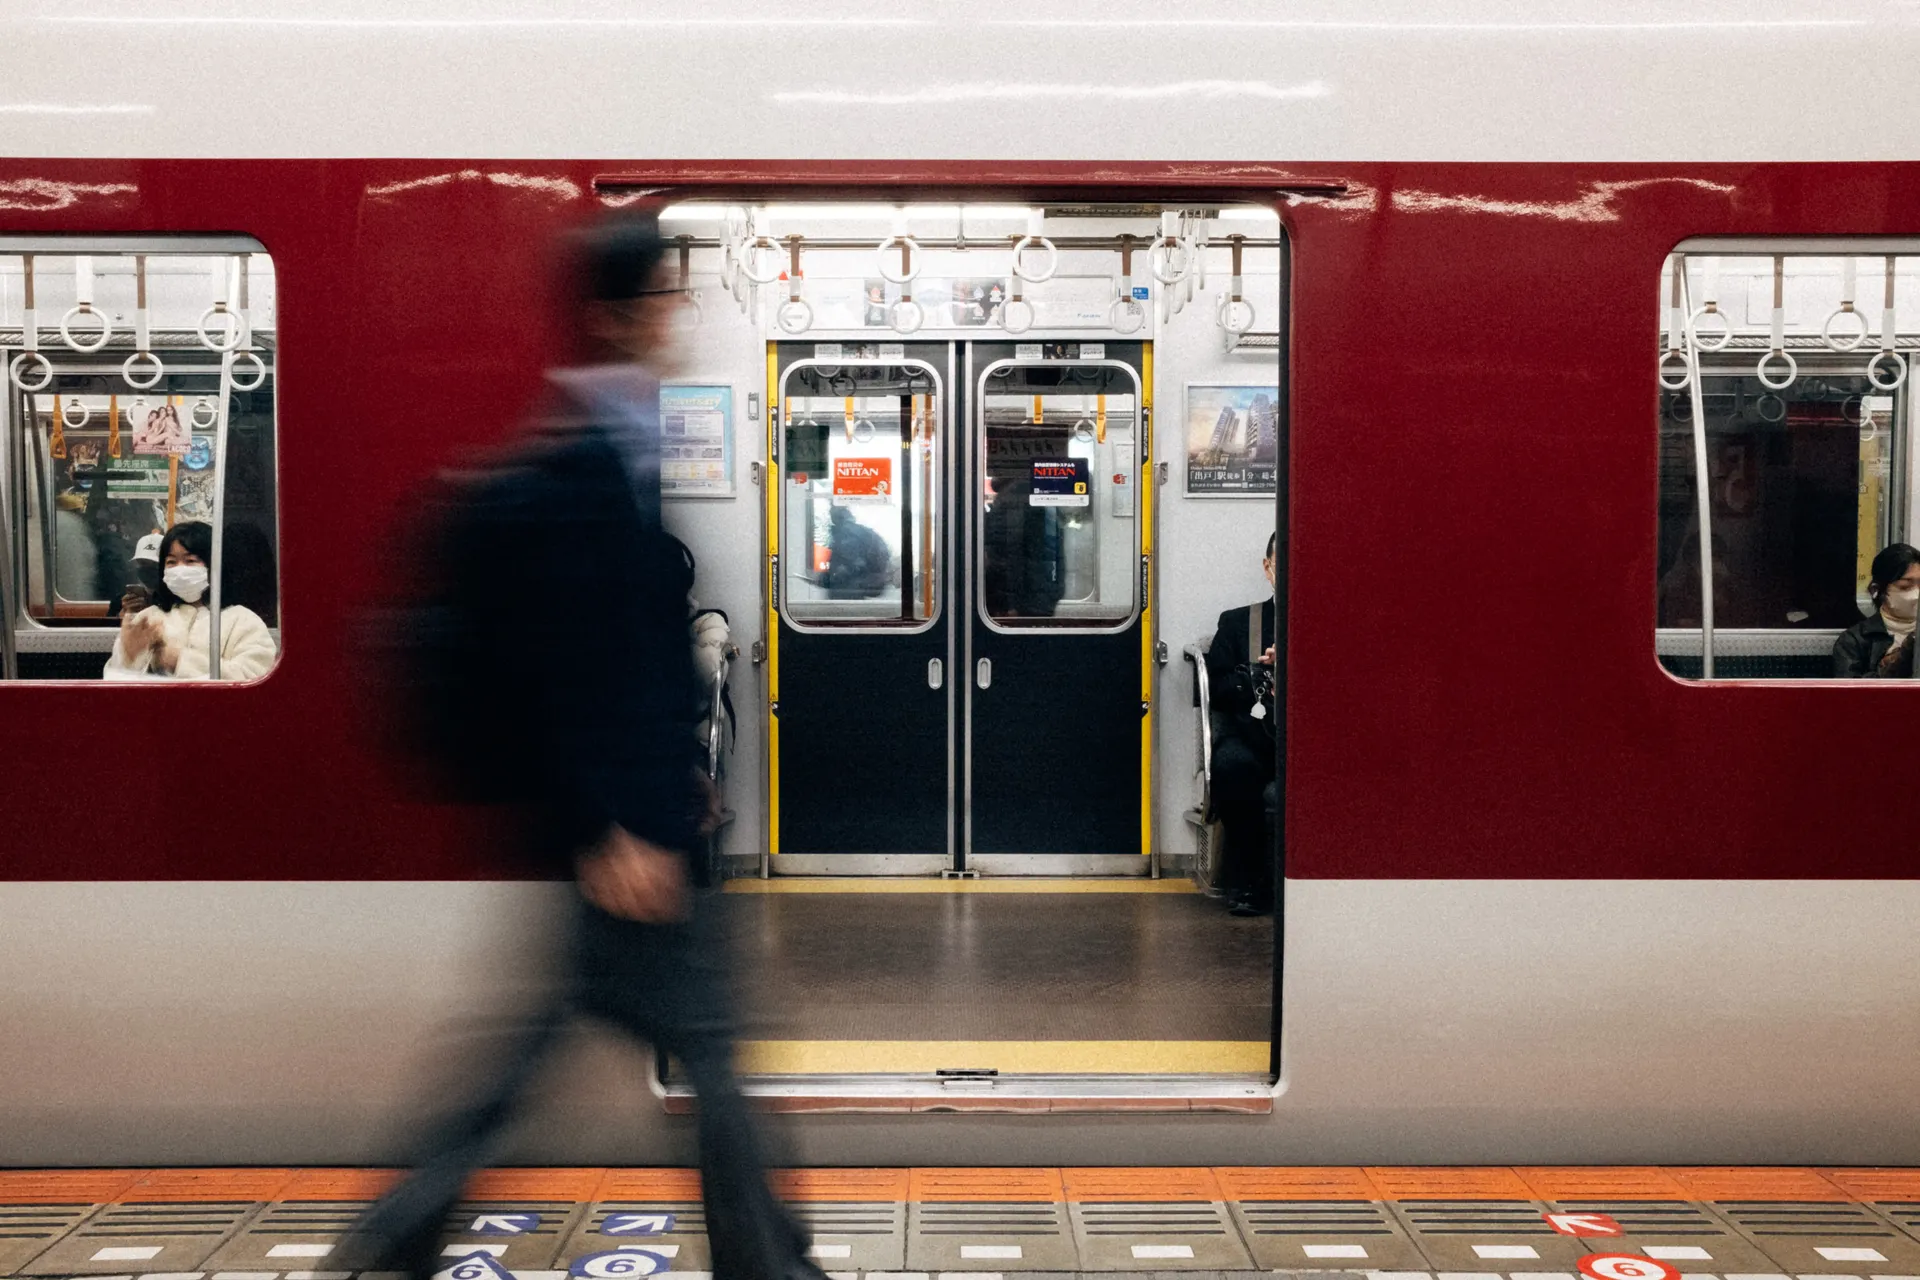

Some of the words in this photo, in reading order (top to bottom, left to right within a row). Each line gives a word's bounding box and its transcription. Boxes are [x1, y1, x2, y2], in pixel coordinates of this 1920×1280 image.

[837, 467, 879, 476] NITTAN
[1033, 467, 1076, 476] NITTAN
[452, 1264, 486, 1280] 6
[605, 1259, 635, 1273] 6
[1613, 1263, 1645, 1276] 6
